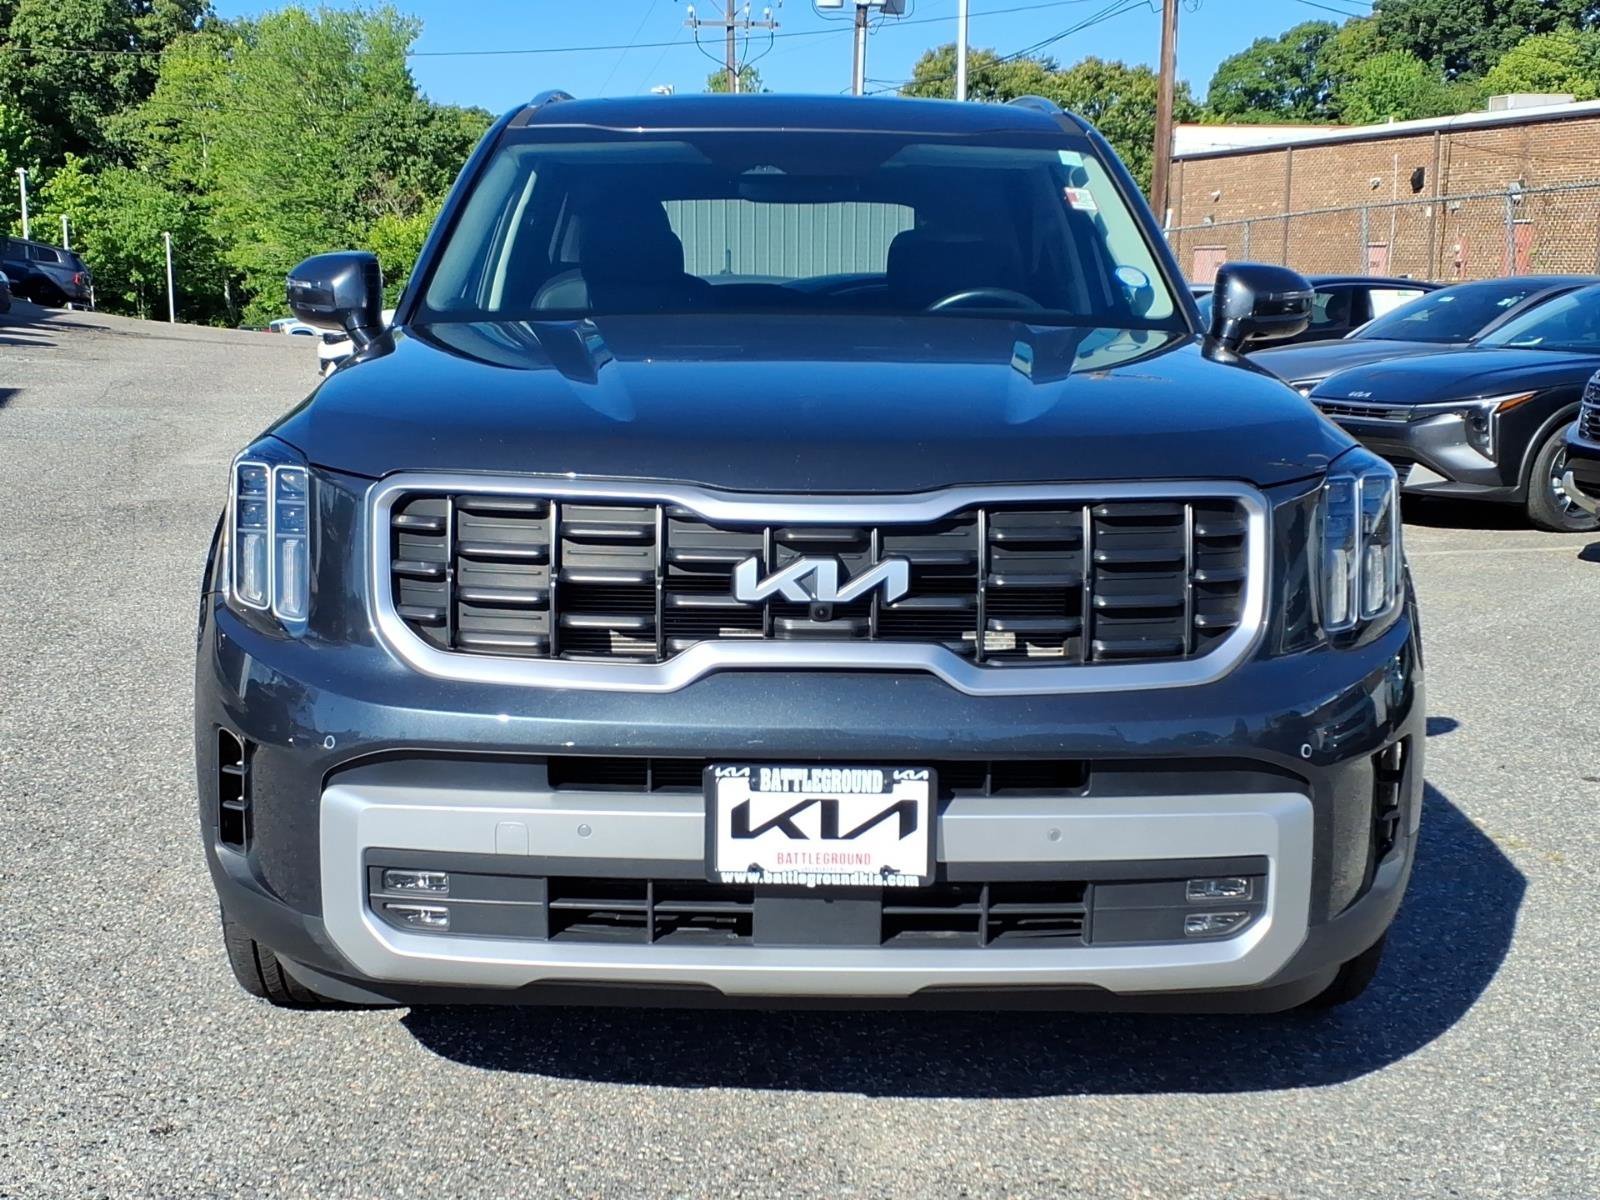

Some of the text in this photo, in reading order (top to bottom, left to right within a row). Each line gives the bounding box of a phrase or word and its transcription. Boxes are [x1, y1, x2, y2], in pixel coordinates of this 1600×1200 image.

[735, 557, 909, 602] KIA
[760, 768, 884, 794] BATTLEGROUND
[731, 798, 918, 840] KIA
[777, 852, 871, 865] BATTLEGROUND
